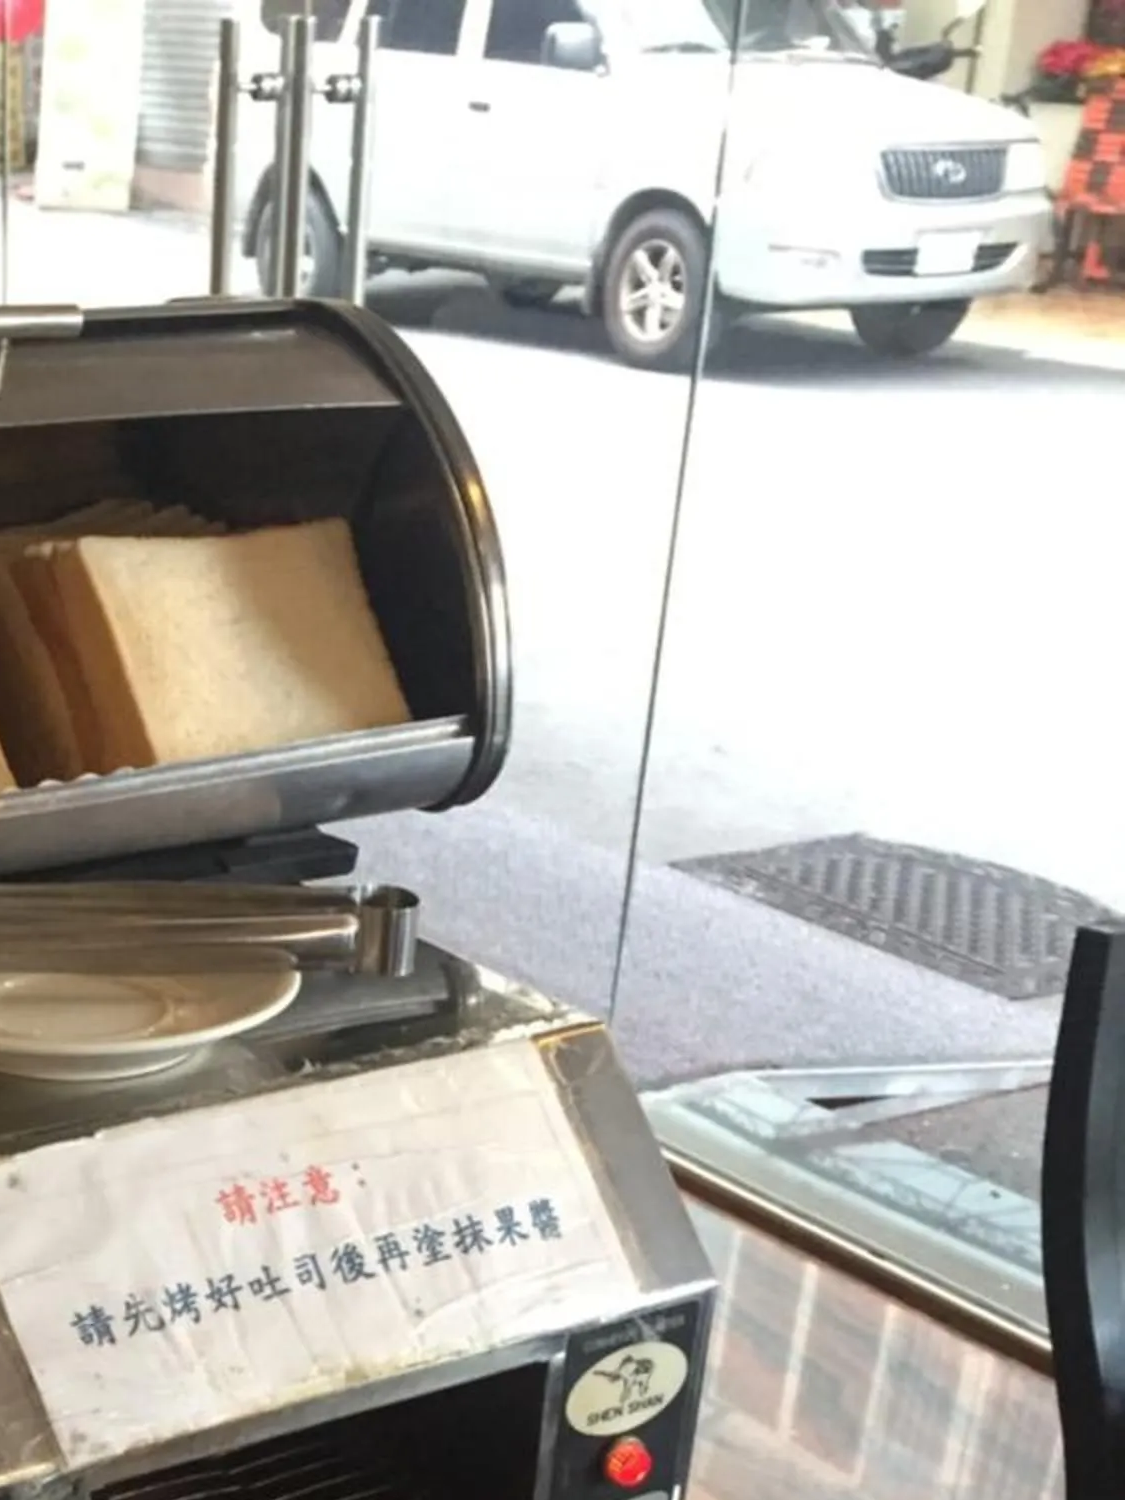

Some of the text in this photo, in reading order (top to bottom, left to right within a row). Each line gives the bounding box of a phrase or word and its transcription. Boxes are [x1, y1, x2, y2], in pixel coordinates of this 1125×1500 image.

[70, 1198, 562, 1346] 請先烤好吐司後再塗抹果醬
[586, 1393, 665, 1427] SHEN SHAN
